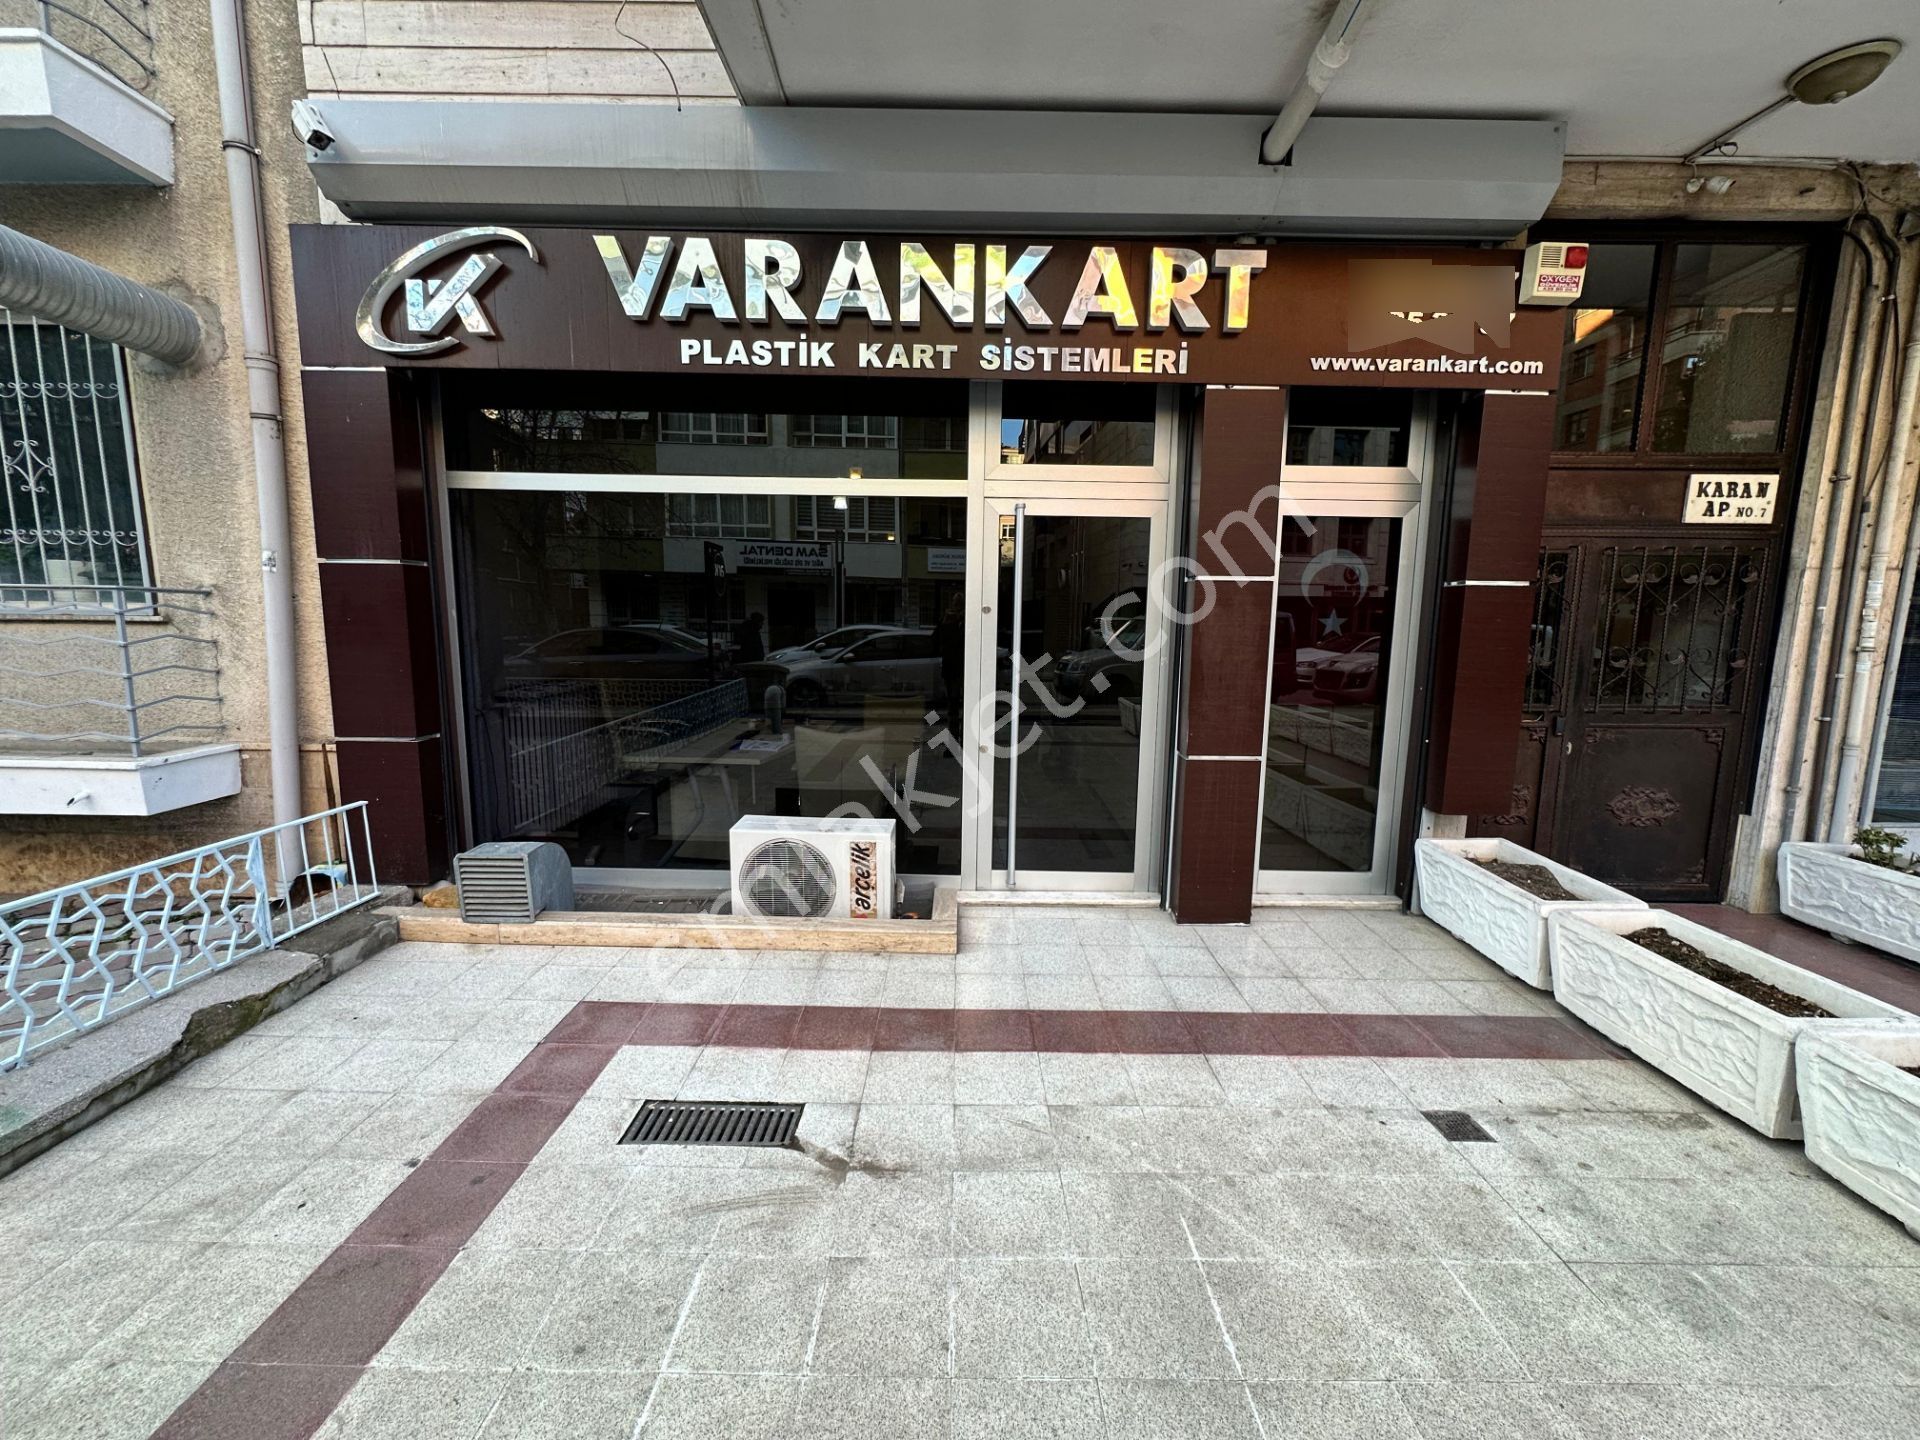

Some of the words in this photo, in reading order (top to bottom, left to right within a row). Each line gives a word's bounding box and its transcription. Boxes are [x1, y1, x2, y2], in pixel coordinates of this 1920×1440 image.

[592, 235, 1267, 332] VARANKART
[1540, 275, 1579, 283] OXYGEN
[680, 333, 835, 368] PLASTİK
[858, 343, 958, 370] KART
[979, 337, 1188, 374] SİSTEMLERİ
[1310, 355, 1543, 374] www.varankart.com
[1696, 481, 1770, 498] KARAN
[851, 842, 874, 910] arçelik
